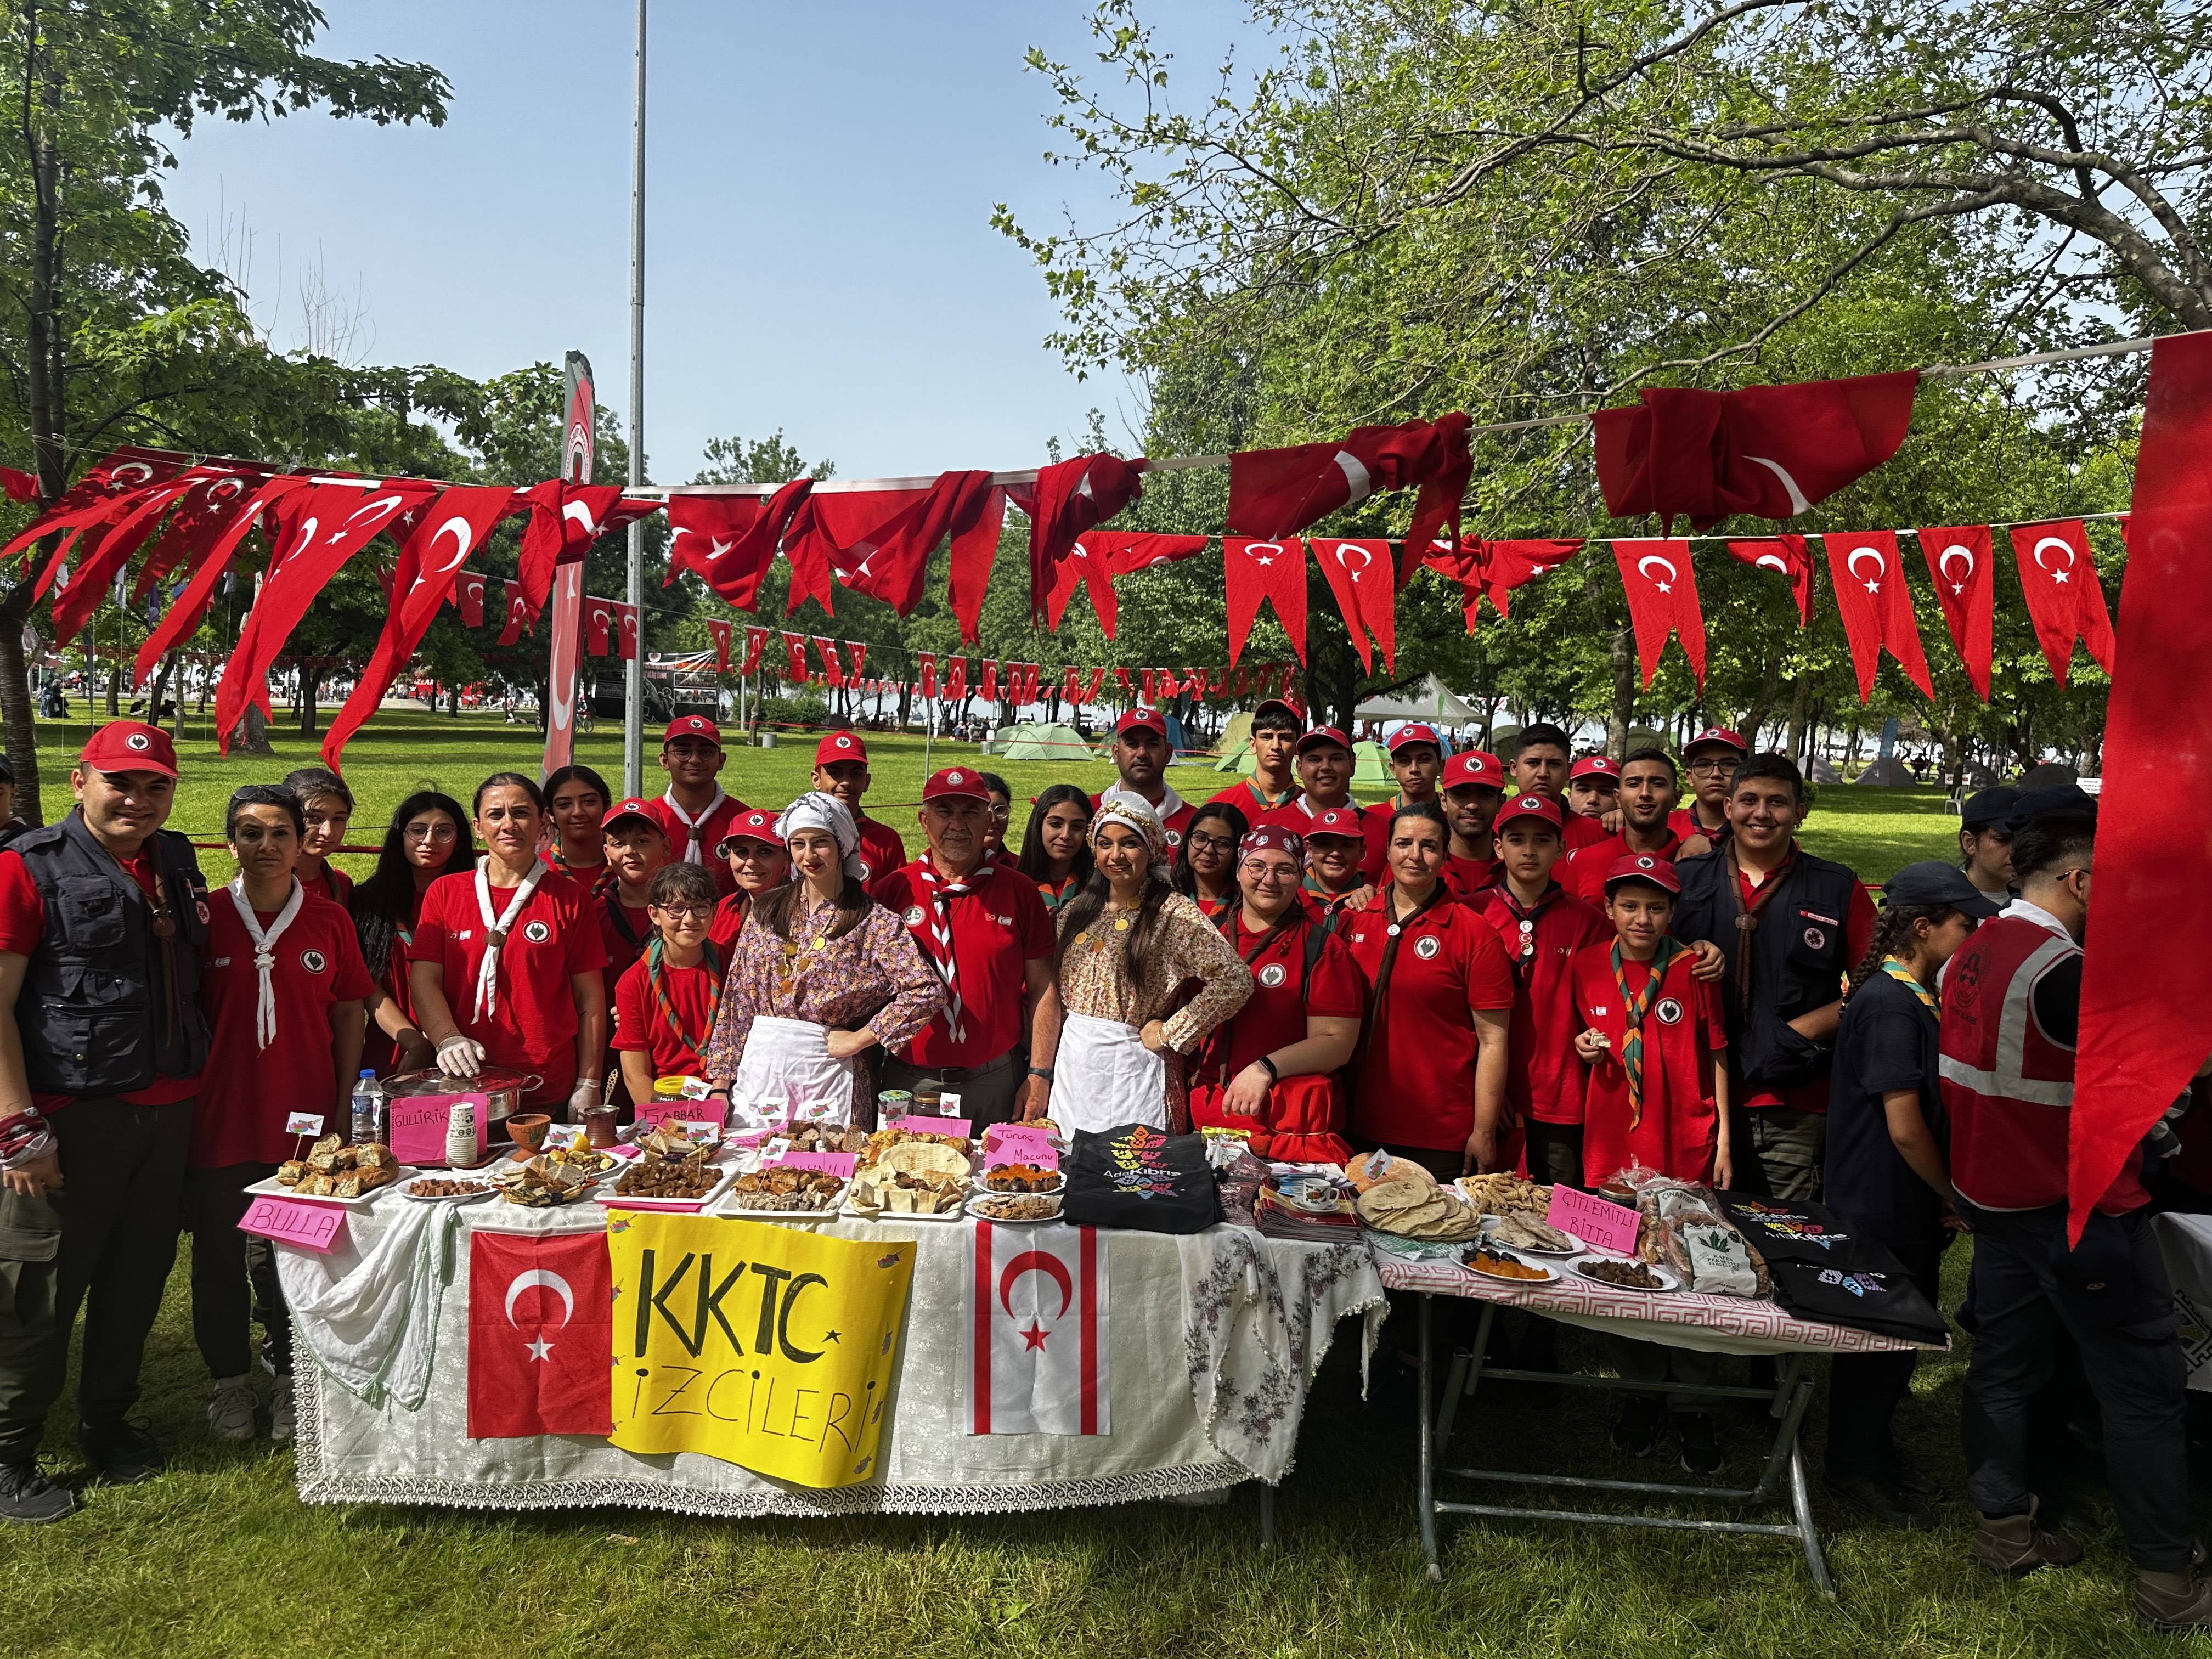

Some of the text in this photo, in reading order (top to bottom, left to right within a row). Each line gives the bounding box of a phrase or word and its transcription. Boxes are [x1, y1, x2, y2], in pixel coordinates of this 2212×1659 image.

[644, 1108, 705, 1124] GABBAR
[997, 1130, 1034, 1143] Turunç
[1013, 1148, 1053, 1161] Macunu
[250, 1204, 335, 1238] BULLA
[1562, 1192, 1635, 1228] ÇİTLEMİTLİ
[1569, 1216, 1613, 1249] BİTTA
[635, 1249, 829, 1364] KKTC
[632, 1365, 876, 1453] İZCİLERİ
